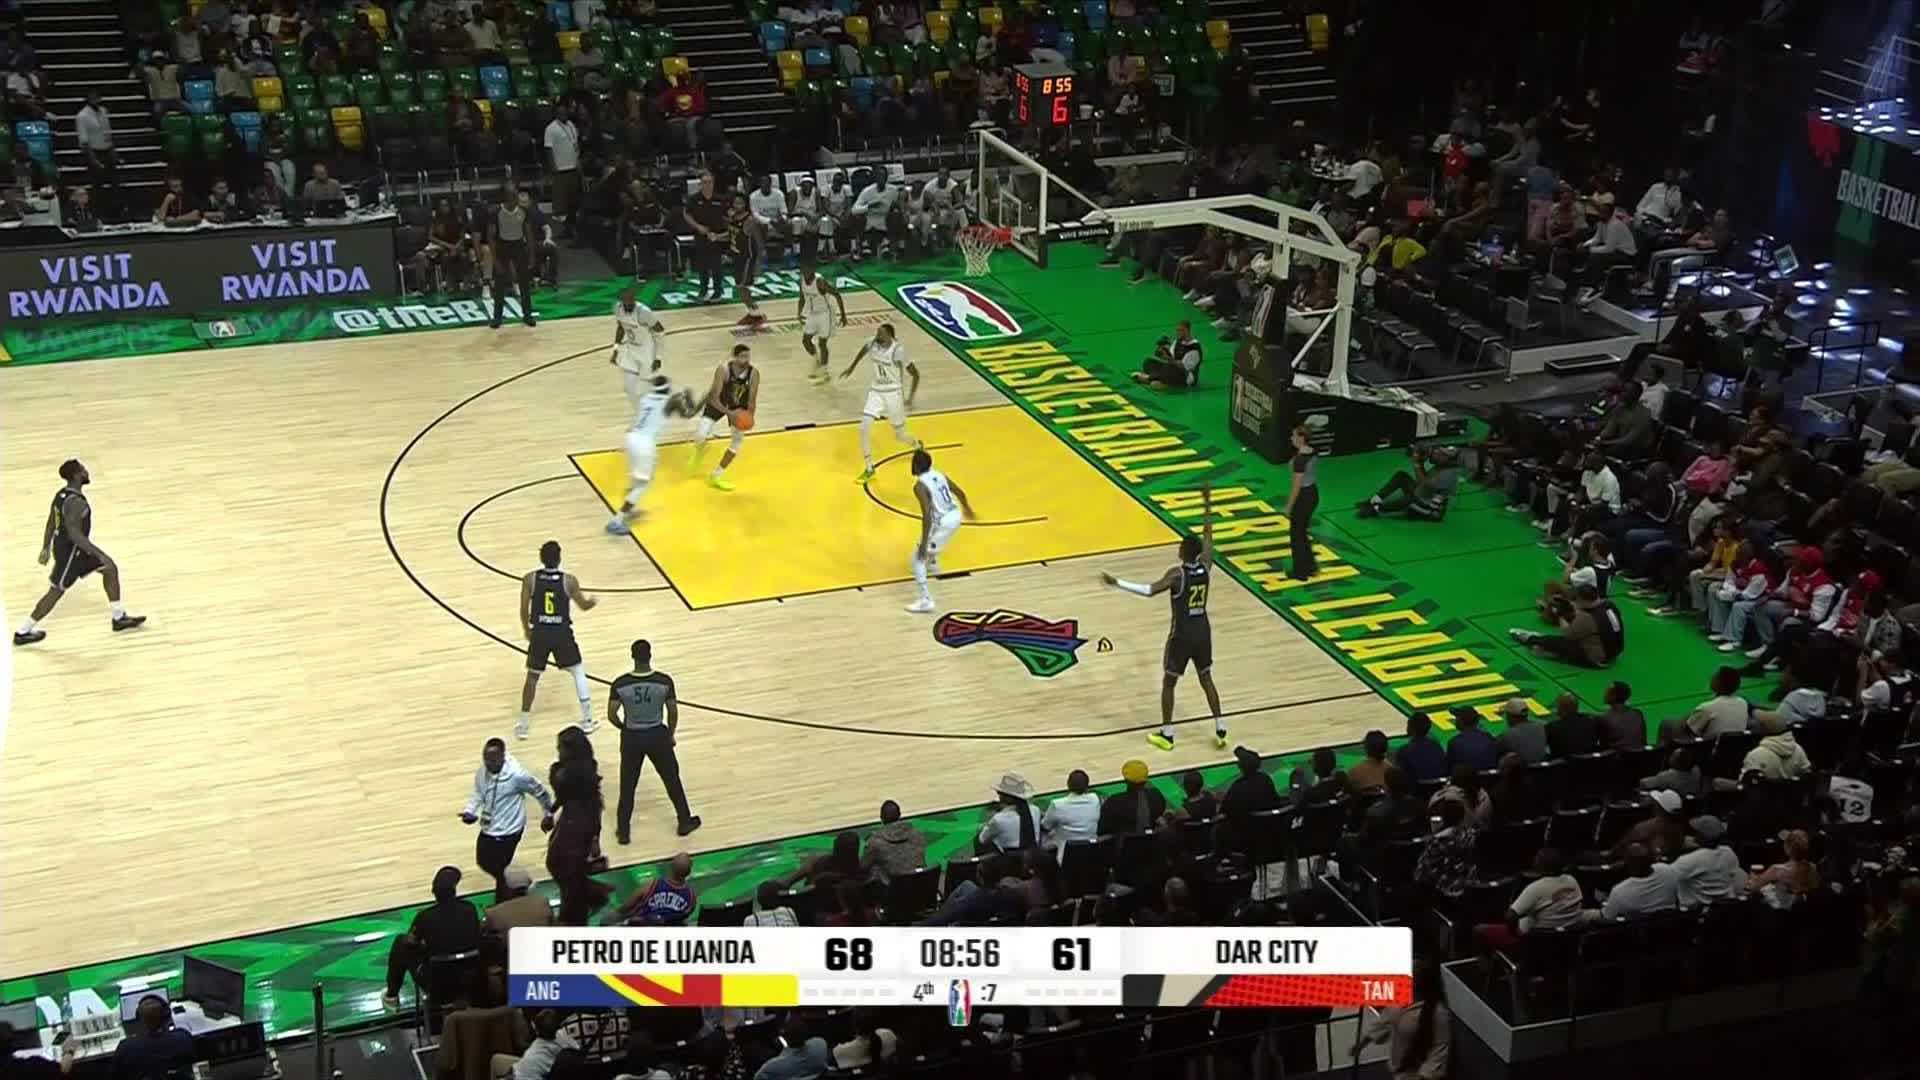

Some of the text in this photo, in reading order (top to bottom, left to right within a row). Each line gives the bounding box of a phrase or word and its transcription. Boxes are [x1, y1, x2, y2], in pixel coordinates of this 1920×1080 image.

[1053, 96, 1067, 122] 6
[40, 253, 132, 284] VISIT
[251, 239, 336, 269] VISIT
[222, 266, 370, 301] RWANDA
[9, 281, 170, 317] RWANDA
[966, 341, 1552, 731] BASKETBALL AFRICA LEAGUE
[545, 591, 554, 614] 6
[1188, 584, 1206, 607] 23
[634, 686, 651, 704] 54
